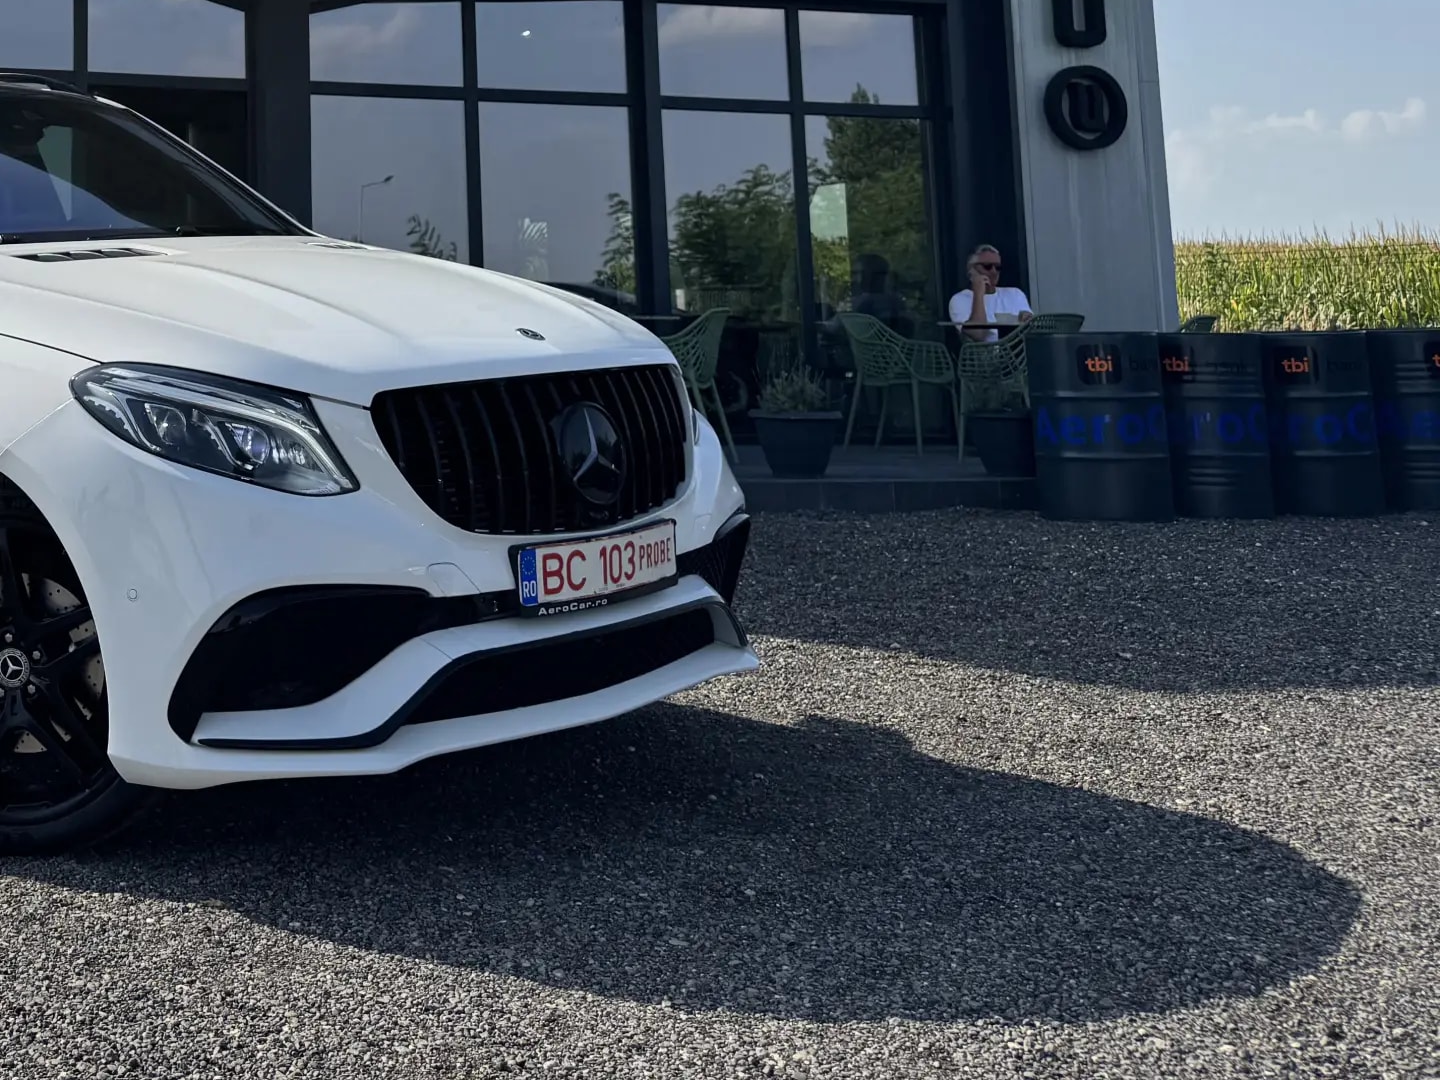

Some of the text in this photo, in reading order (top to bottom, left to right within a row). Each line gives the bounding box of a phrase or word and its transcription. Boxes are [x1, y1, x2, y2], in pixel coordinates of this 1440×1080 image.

[1085, 355, 1113, 373] tbi
[1162, 356, 1189, 373] tbi
[1281, 357, 1309, 373] tbi
[522, 537, 671, 598] RO BC 103 PROBE
[538, 598, 608, 616] AeroCar.ro
